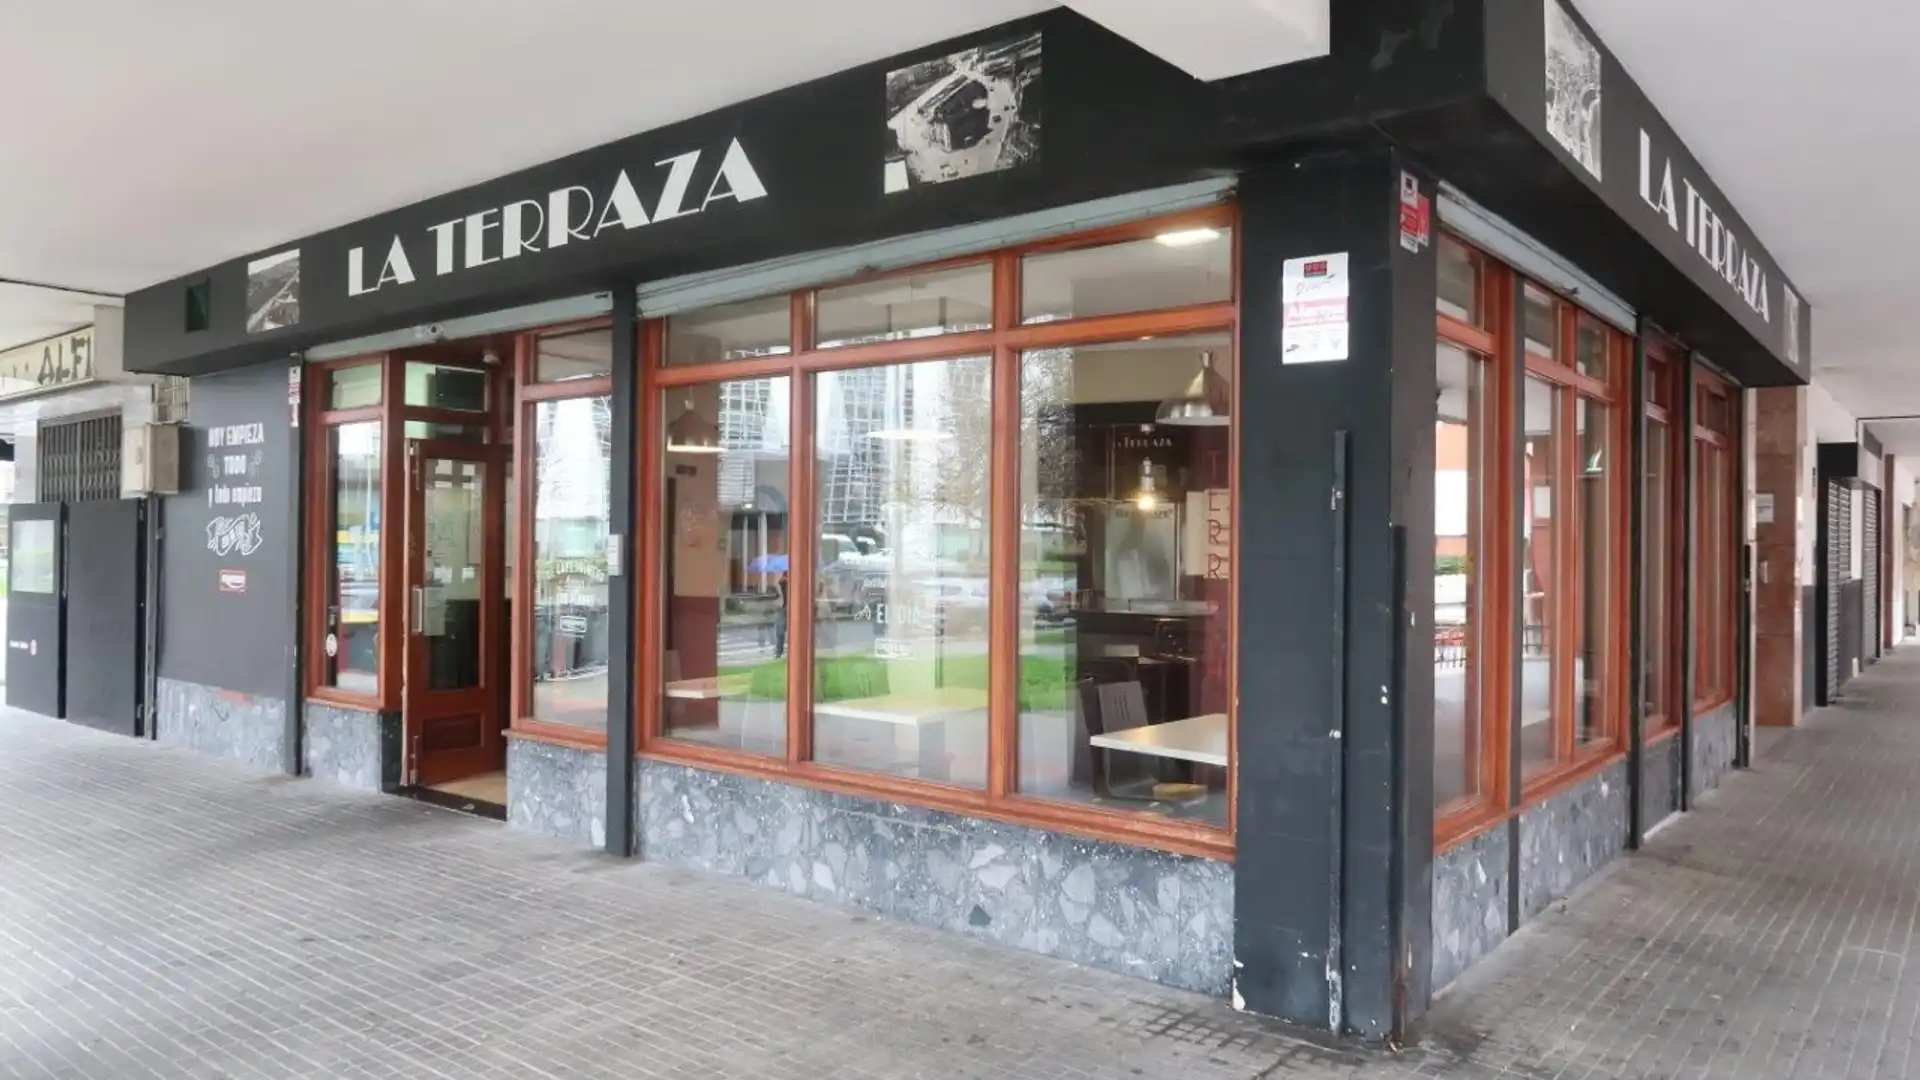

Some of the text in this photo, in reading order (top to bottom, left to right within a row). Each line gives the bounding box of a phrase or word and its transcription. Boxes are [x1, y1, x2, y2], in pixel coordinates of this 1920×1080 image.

[348, 136, 768, 297] LA TERRAZA
[1640, 127, 1770, 323] LA TERRAZA
